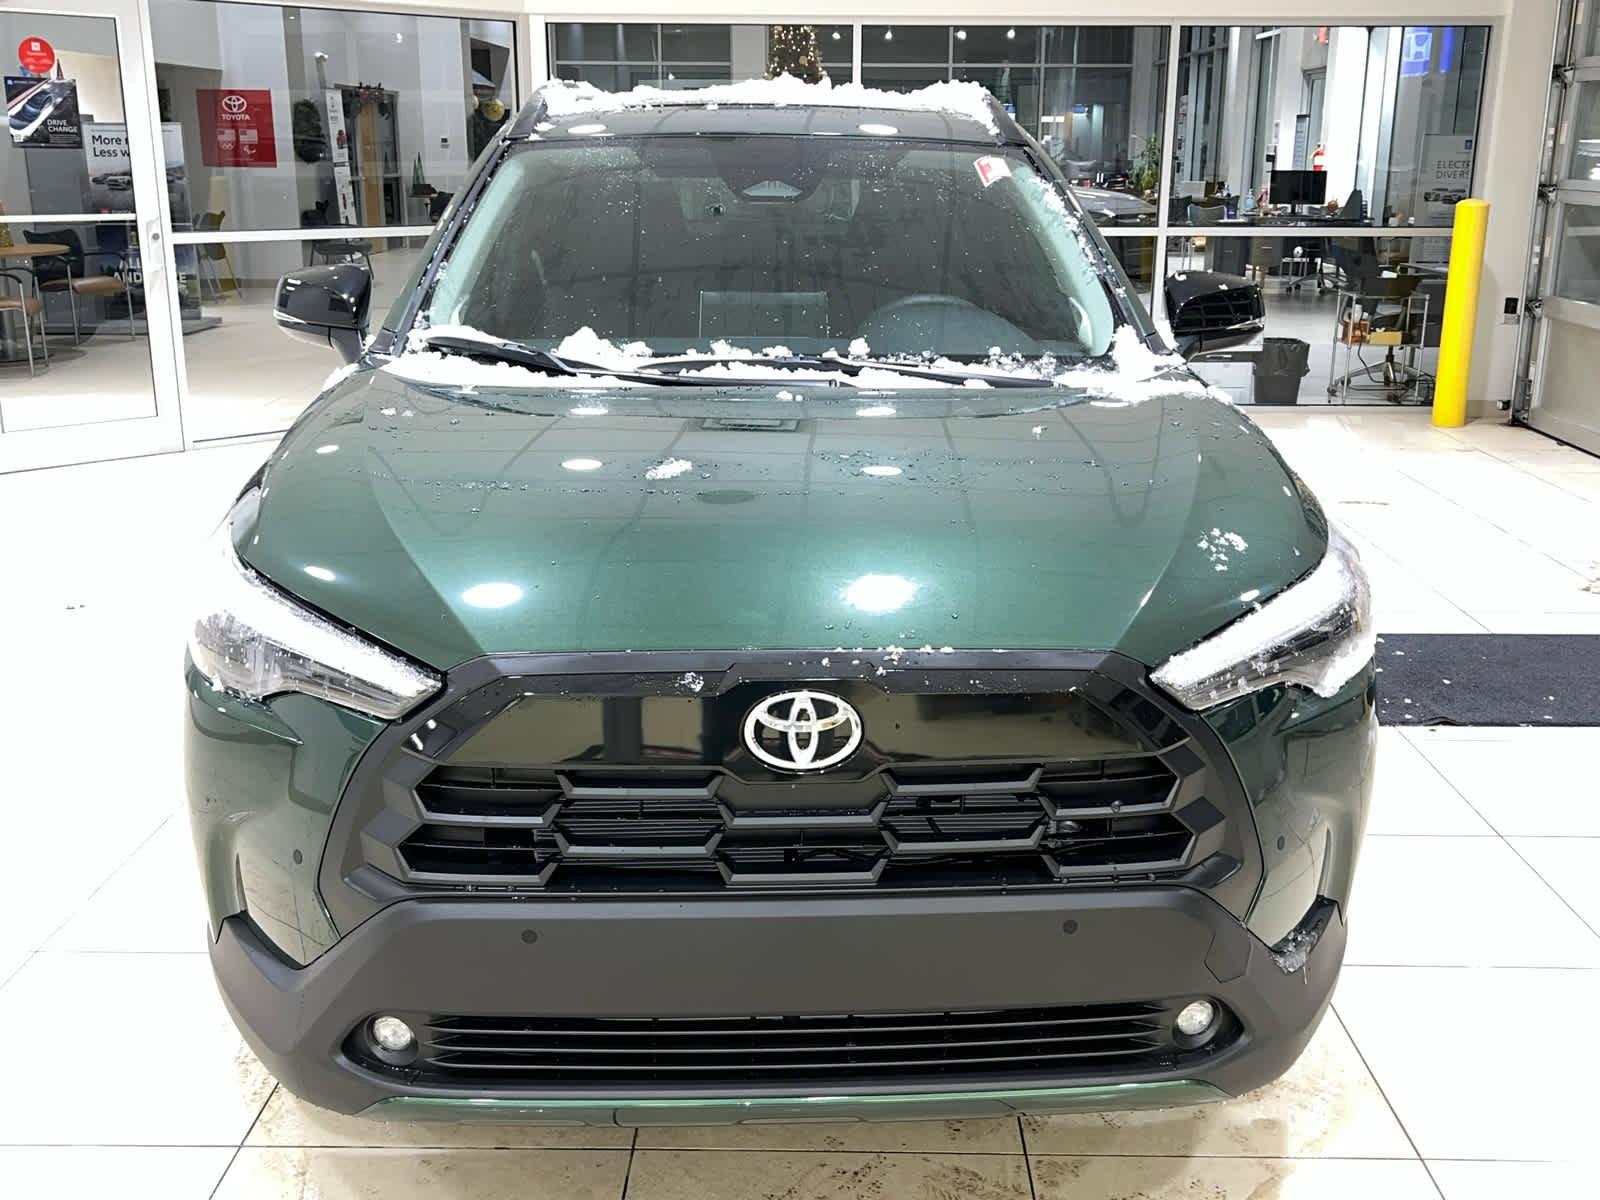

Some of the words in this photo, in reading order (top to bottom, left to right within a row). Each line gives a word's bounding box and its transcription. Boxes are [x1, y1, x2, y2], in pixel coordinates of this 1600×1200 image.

[222, 113, 251, 121] TOYOTA
[46, 118, 68, 126] DRIVE
[91, 135, 122, 145] More
[93, 147, 118, 157] Less
